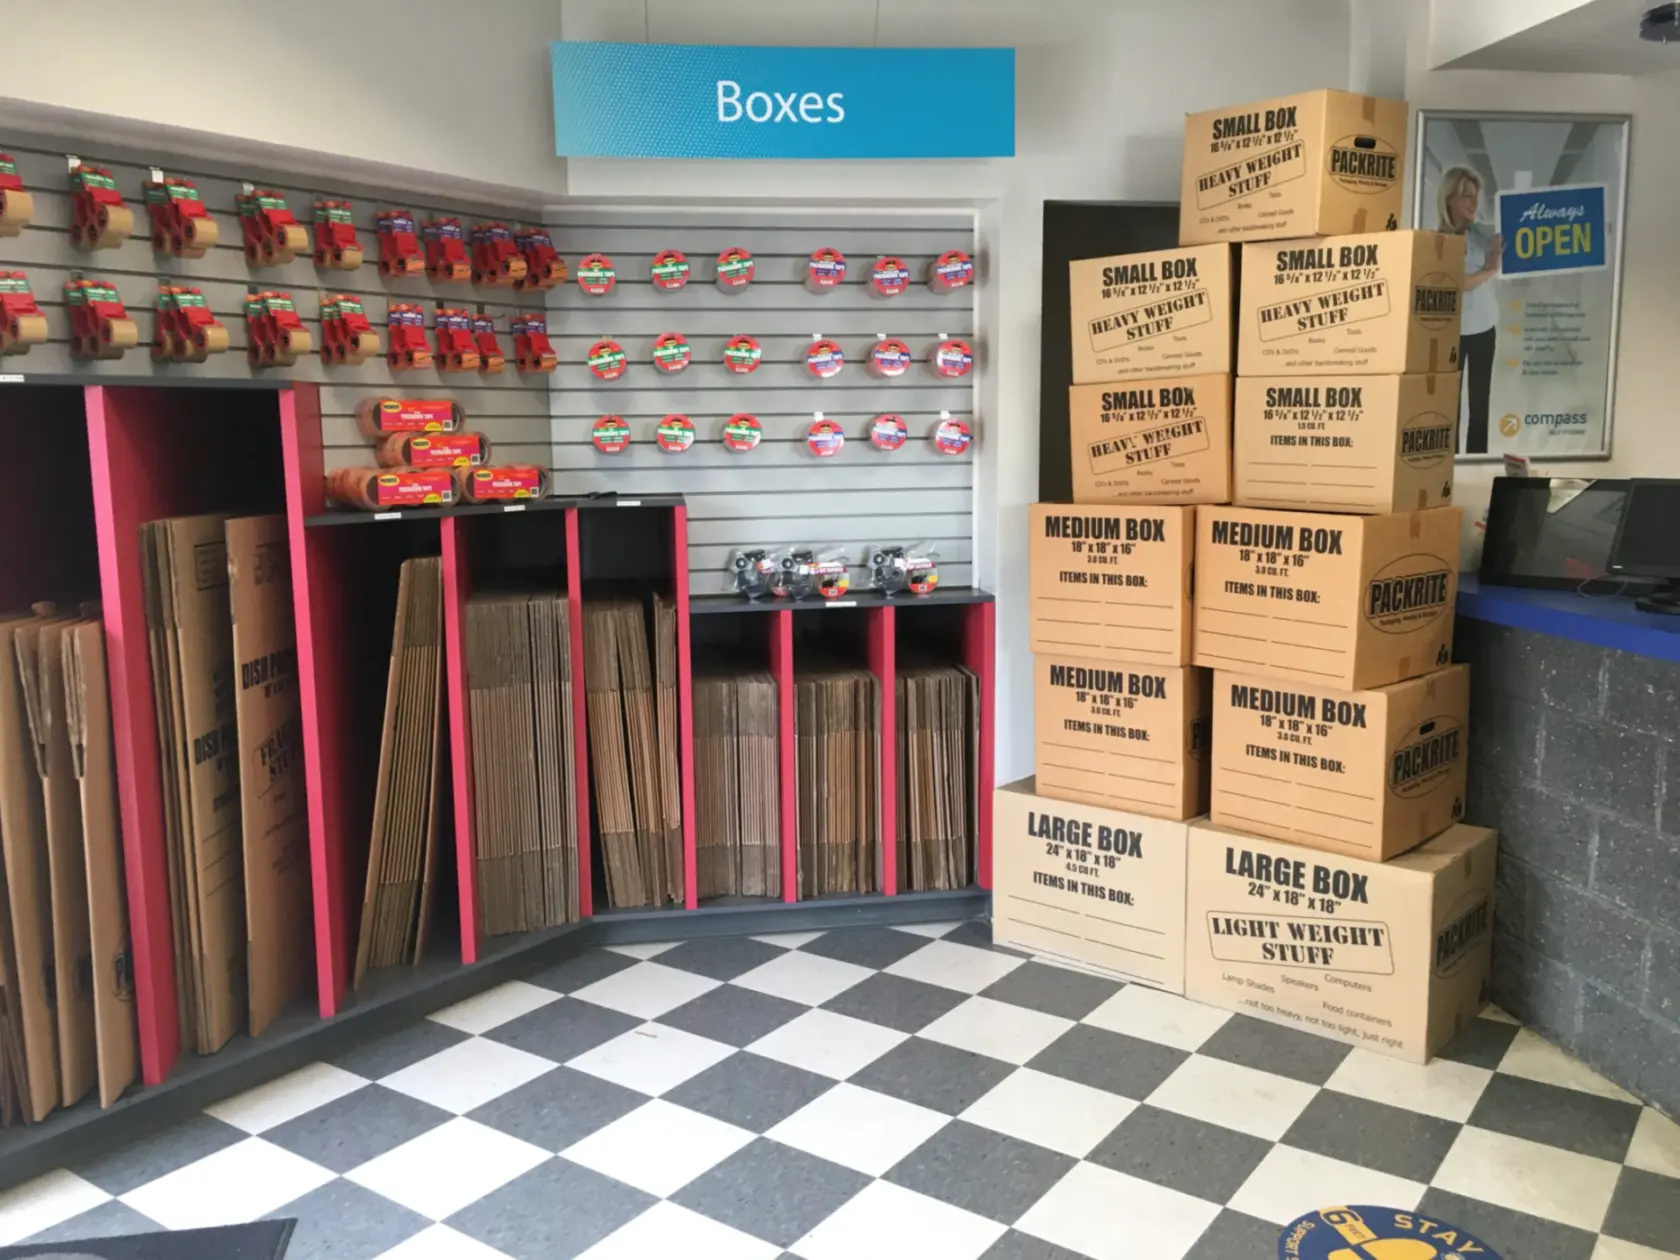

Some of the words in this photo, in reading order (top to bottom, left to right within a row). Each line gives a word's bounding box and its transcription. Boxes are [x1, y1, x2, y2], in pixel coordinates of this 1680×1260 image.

[717, 80, 845, 123] Boxes
[1213, 112, 1260, 140] SMALL
[1265, 106, 1297, 131] BOX
[1199, 166, 1242, 192] HEAVY
[1246, 144, 1302, 173] WEIGHT
[1332, 149, 1395, 180] PACKRITE
[1229, 172, 1272, 198] STUFF
[1519, 202, 1586, 222] Always
[1516, 222, 1590, 259] OPEN
[1276, 248, 1334, 272] SMALL
[1340, 244, 1378, 267] BOX
[1103, 262, 1157, 287] SMALL
[1162, 258, 1198, 279] BOX
[1274, 273, 1284, 284] 16
[1305, 273, 1310, 282] x
[1313, 271, 1322, 282] 12
[1342, 272, 1348, 281] x
[1351, 269, 1360, 280] 12
[1091, 311, 1139, 335] HEAVY
[1144, 292, 1205, 320] WEIGHT
[1261, 299, 1312, 323] HEAVY
[1318, 282, 1385, 309] WEIGHT
[1416, 289, 1456, 312] PACKRITE
[1126, 316, 1173, 340] STUFF
[1297, 308, 1348, 331] STUFF
[1102, 390, 1155, 411] SMALL
[1160, 387, 1195, 406] BOX
[1266, 388, 1320, 407] SMALL
[1326, 387, 1362, 408] BOX
[1264, 410, 1273, 420] 16
[1293, 411, 1298, 420] x
[1300, 410, 1310, 420] 12
[1336, 411, 1345, 420] 12
[1525, 413, 1587, 427] compass
[1091, 436, 1138, 458] HEAVY
[1142, 421, 1202, 445] WEIGHT
[1271, 436, 1296, 446] ITEMS
[1299, 436, 1307, 446] IN
[1310, 436, 1330, 447] THIS
[1332, 437, 1353, 448] BOX:
[1402, 428, 1450, 453] PACKRITE
[1125, 443, 1172, 465] STUFF
[1046, 516, 1120, 539] MEDIUM
[1126, 518, 1165, 542] BOX
[1212, 521, 1293, 551] MEDIUM
[1299, 528, 1342, 555] BOX
[1072, 541, 1086, 552] 18"
[1088, 544, 1093, 553] x
[1096, 542, 1111, 553] 18"
[1113, 544, 1118, 554] x
[1120, 543, 1136, 554] 16"
[1239, 549, 1255, 561] 18"
[1257, 554, 1262, 563] x
[1266, 552, 1282, 564] 18"
[1284, 556, 1289, 566] x
[1293, 554, 1309, 567] 16"
[1060, 571, 1087, 583] ITEMS
[1090, 573, 1099, 584] IN
[1101, 574, 1123, 586] THIS
[1126, 575, 1148, 587] BOX:
[1225, 581, 1254, 595] ITEMS
[1257, 585, 1267, 596] IN
[1270, 586, 1293, 600] THIS
[1296, 589, 1320, 603] BOX:
[1370, 573, 1447, 616] PACKRITE
[242, 656, 268, 689] DISH
[1051, 665, 1123, 693] MEDIUM
[1128, 674, 1166, 699] BOX
[1076, 691, 1090, 702] 18"
[1092, 695, 1097, 703] x
[1100, 694, 1114, 706] 18"
[1116, 698, 1121, 707] x
[1123, 697, 1138, 708] 16"
[1231, 684, 1315, 720] MEDIUM
[1322, 698, 1367, 728] BOX
[1064, 720, 1091, 733] ITEMS
[1093, 723, 1103, 734] IN
[1105, 725, 1126, 738] THIS
[1128, 728, 1150, 741] BOX:
[1260, 714, 1277, 727] 18"
[1279, 719, 1284, 729] x
[1288, 718, 1304, 732] 18"
[1306, 724, 1312, 734] x
[1316, 723, 1333, 737] 16"
[1277, 732, 1288, 741] 3.0
[1246, 744, 1277, 759] ITEMS
[1279, 750, 1290, 763] IN
[1293, 752, 1317, 768] THIS
[1320, 757, 1345, 773] BOX:
[1393, 731, 1460, 786] PACKRITE
[1028, 812, 1092, 848] LARGE
[1098, 826, 1143, 858] BOX
[1046, 843, 1064, 856] 24"
[1066, 849, 1073, 859] x
[1075, 850, 1092, 862] 18"
[1094, 855, 1100, 865] x
[1103, 856, 1121, 869] 18"
[1066, 863, 1077, 872] 4.5
[1090, 867, 1099, 877] FT.
[1226, 847, 1305, 890] LARGE
[1313, 866, 1368, 904] BOX
[1033, 871, 1064, 889] ITEMS
[1067, 880, 1078, 892] IN
[1081, 882, 1106, 899] THIS
[1108, 889, 1134, 906] BOX:
[1248, 882, 1270, 897] 24"
[1273, 890, 1280, 901] x
[1284, 890, 1305, 906] 18"
[1308, 898, 1315, 910] x
[1319, 898, 1341, 913] 18"
[1212, 918, 1279, 939] LIGHT
[1287, 922, 1384, 946] WEIGHT
[1437, 900, 1488, 968] PACKRITE
[1262, 942, 1334, 965] STUFF
[1222, 972, 1243, 986] Lamp
[1246, 978, 1275, 993] Shades
[1281, 974, 1319, 991] Speakers
[1325, 973, 1372, 992] Computers
[1261, 1003, 1274, 1012] too
[1277, 1006, 1302, 1021] heavy,
[1305, 1014, 1319, 1024] not
[1322, 1019, 1336, 1030] too
[1339, 1021, 1360, 1038] light,
[1362, 1030, 1379, 1043] just
[1382, 1032, 1403, 1049] right
[1322, 1001, 1343, 1014] Food
[1346, 1008, 1392, 1027] containers
[1322, 1210, 1360, 1225] 6
[1394, 1213, 1484, 1253] STAY
